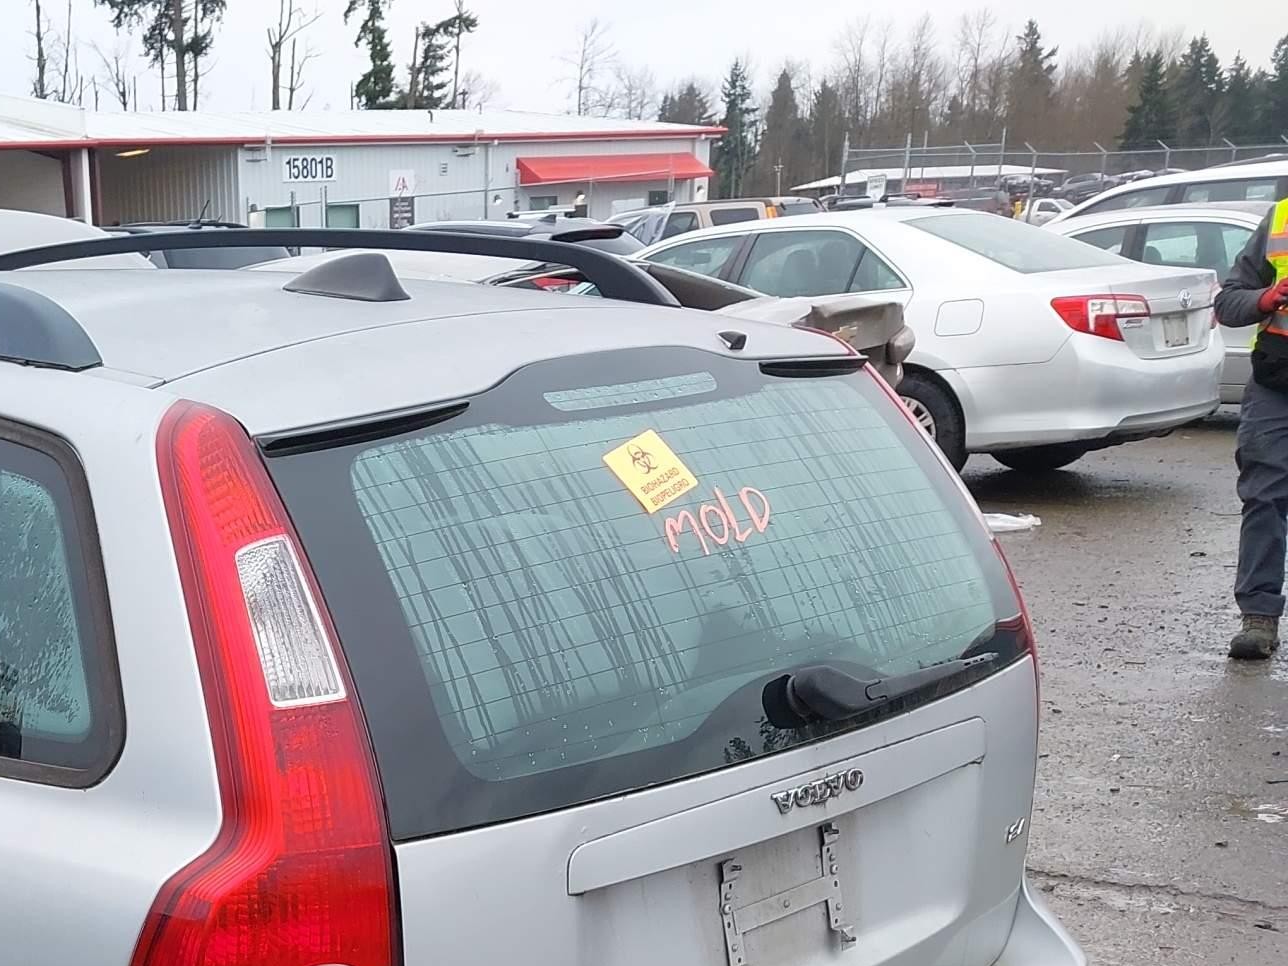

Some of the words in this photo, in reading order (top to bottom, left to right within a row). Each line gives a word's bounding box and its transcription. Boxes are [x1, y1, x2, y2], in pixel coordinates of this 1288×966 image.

[285, 157, 334, 179] 15801B
[640, 467, 680, 496] BIOHAZARD
[650, 478, 690, 506] BIOPELIGRO
[665, 486, 770, 555] MOLD
[771, 768, 864, 815] VOLVO
